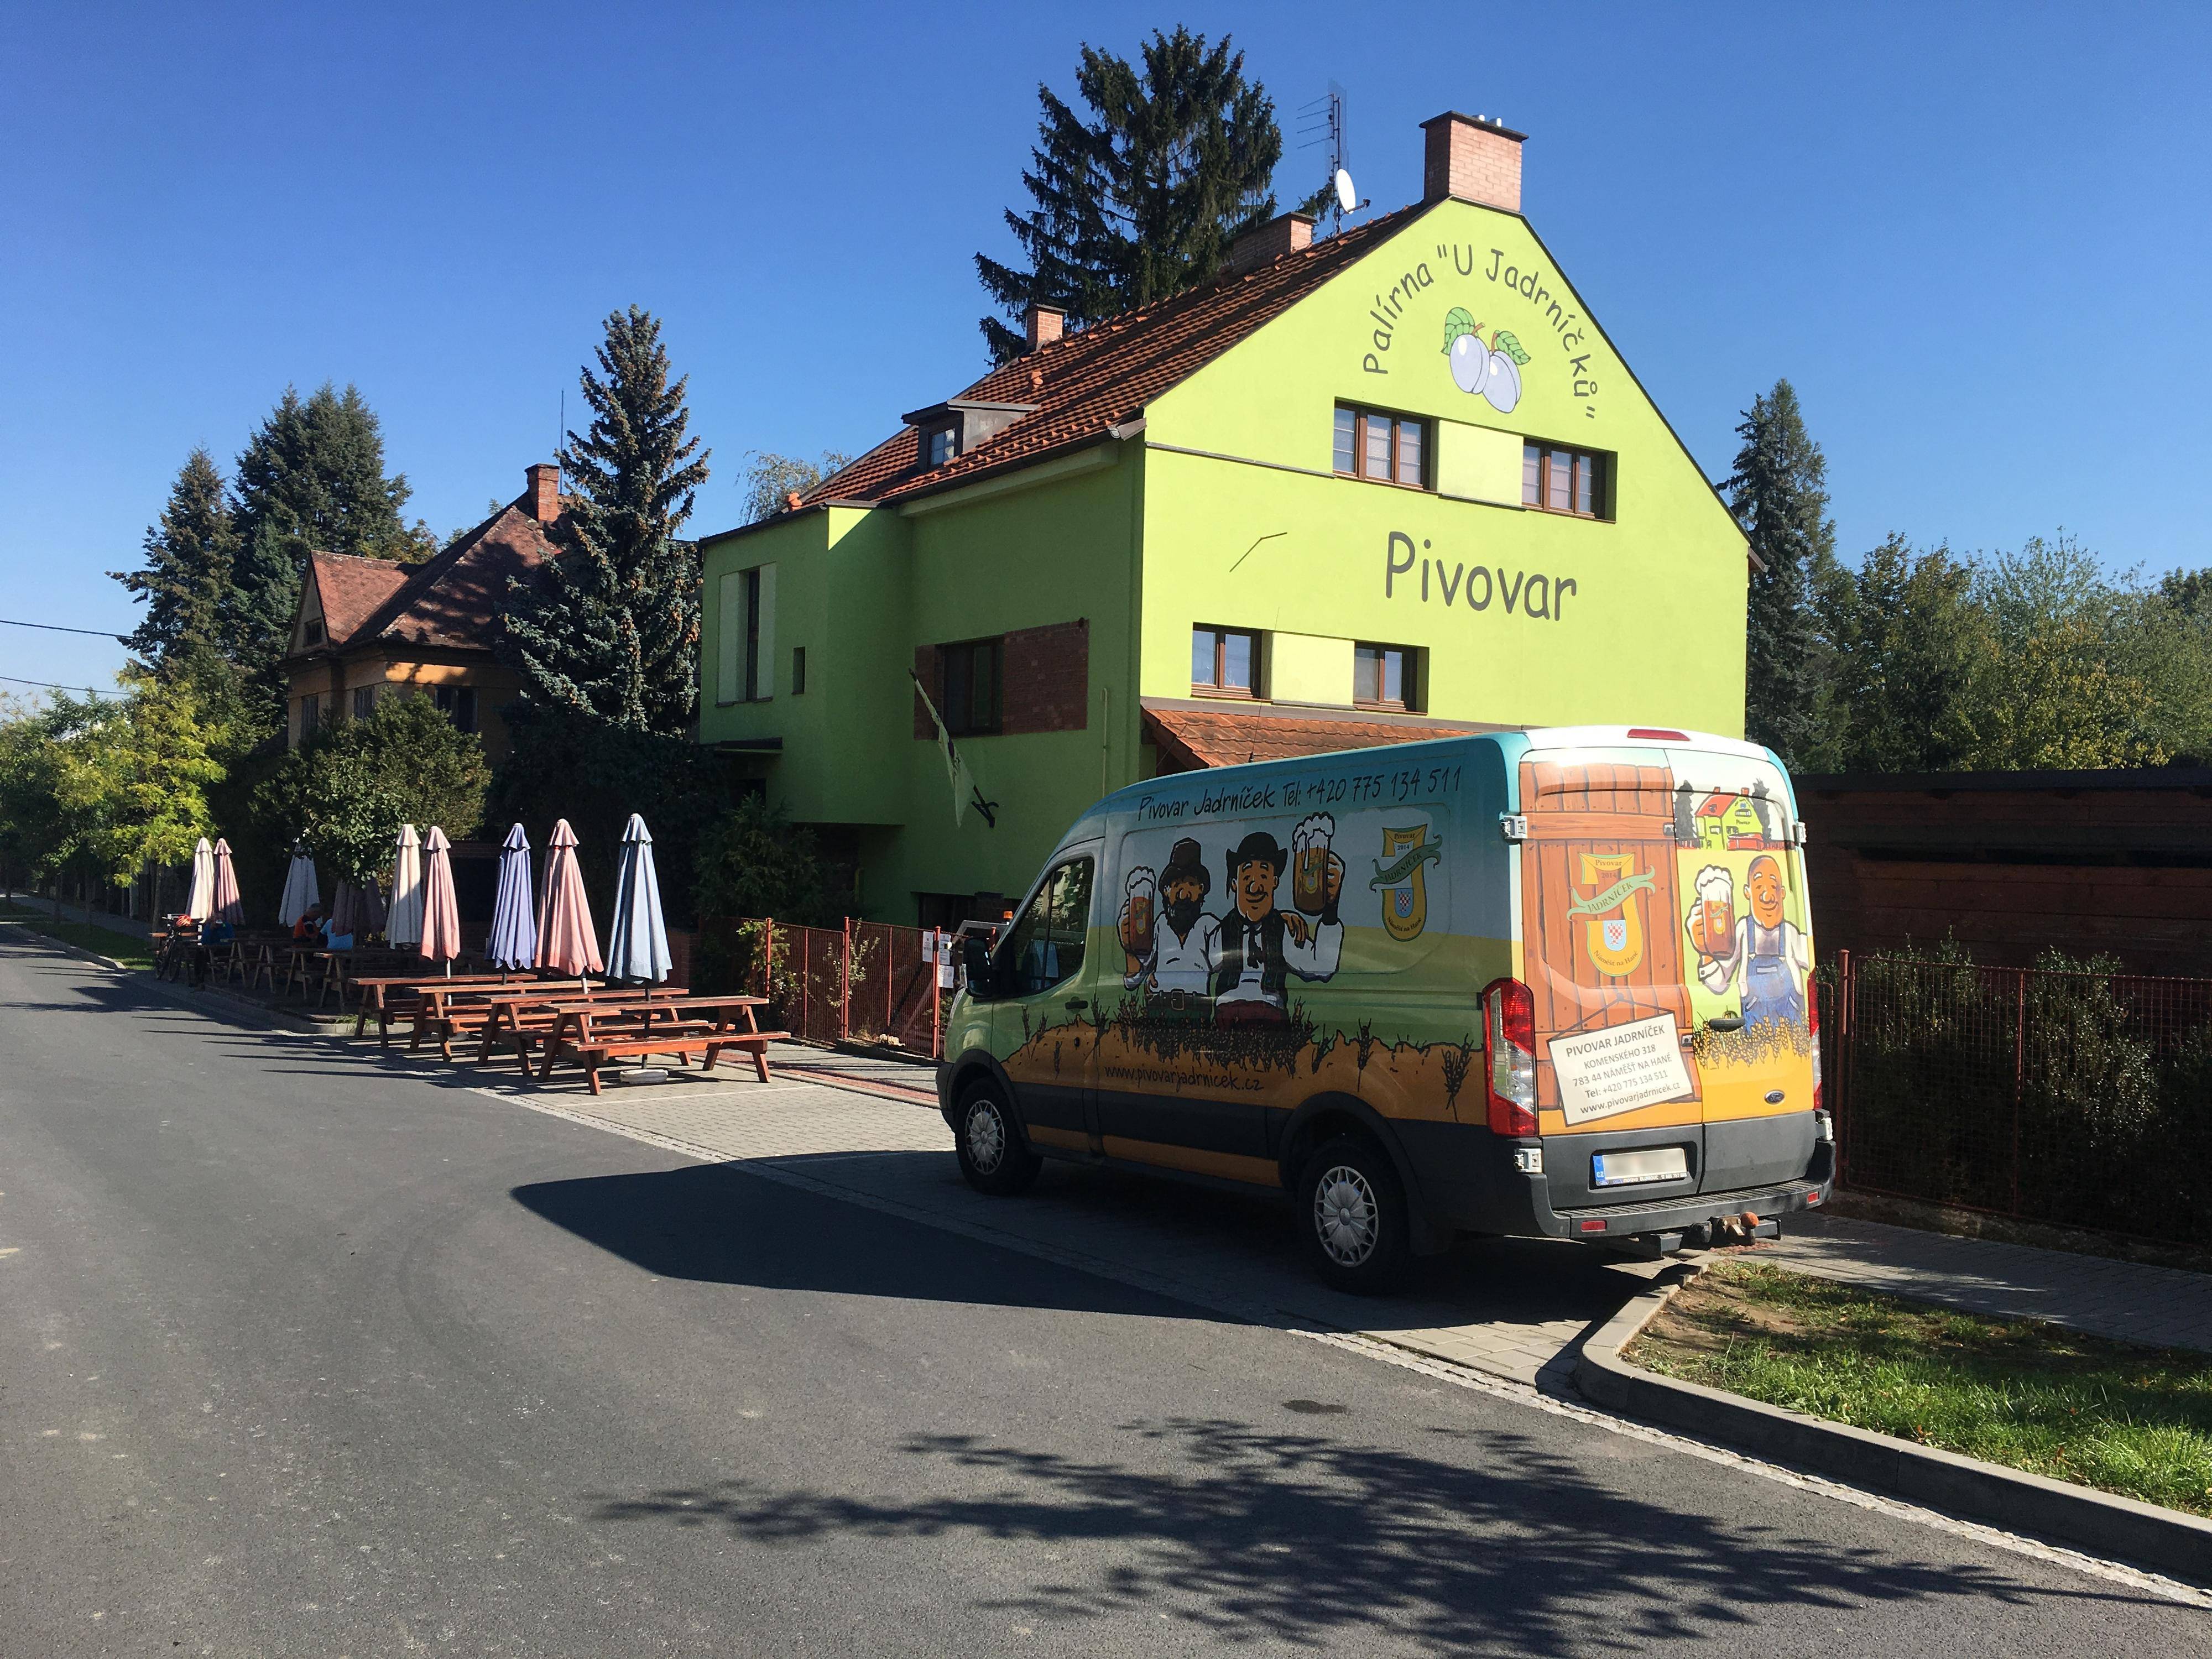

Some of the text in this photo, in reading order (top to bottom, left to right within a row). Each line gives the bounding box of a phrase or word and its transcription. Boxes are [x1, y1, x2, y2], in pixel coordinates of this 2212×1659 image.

[1363, 263, 1434, 374] Palírna
[1386, 531, 1577, 621] Pivovar
[1138, 765, 1462, 821] Pivovar Jadrníček Tel: +420 775 134 511
[1588, 881, 1634, 914] JADRNÍČEK
[1566, 1025, 1665, 1057] PIVOVAR JADRNÍČEK
[1584, 1044, 1656, 1070] KOMENSKÉHO 318
[1104, 1063, 1264, 1092] www.pivovarjadrnicek.cz
[1573, 1052, 1672, 1087] 783 44 NÁMĚŠŤ NA HANÉ
[1585, 1070, 1668, 1099] Tel: +420 775 134 511
[1580, 1082, 1681, 1114] www.pivovarjadrnicek.cz
